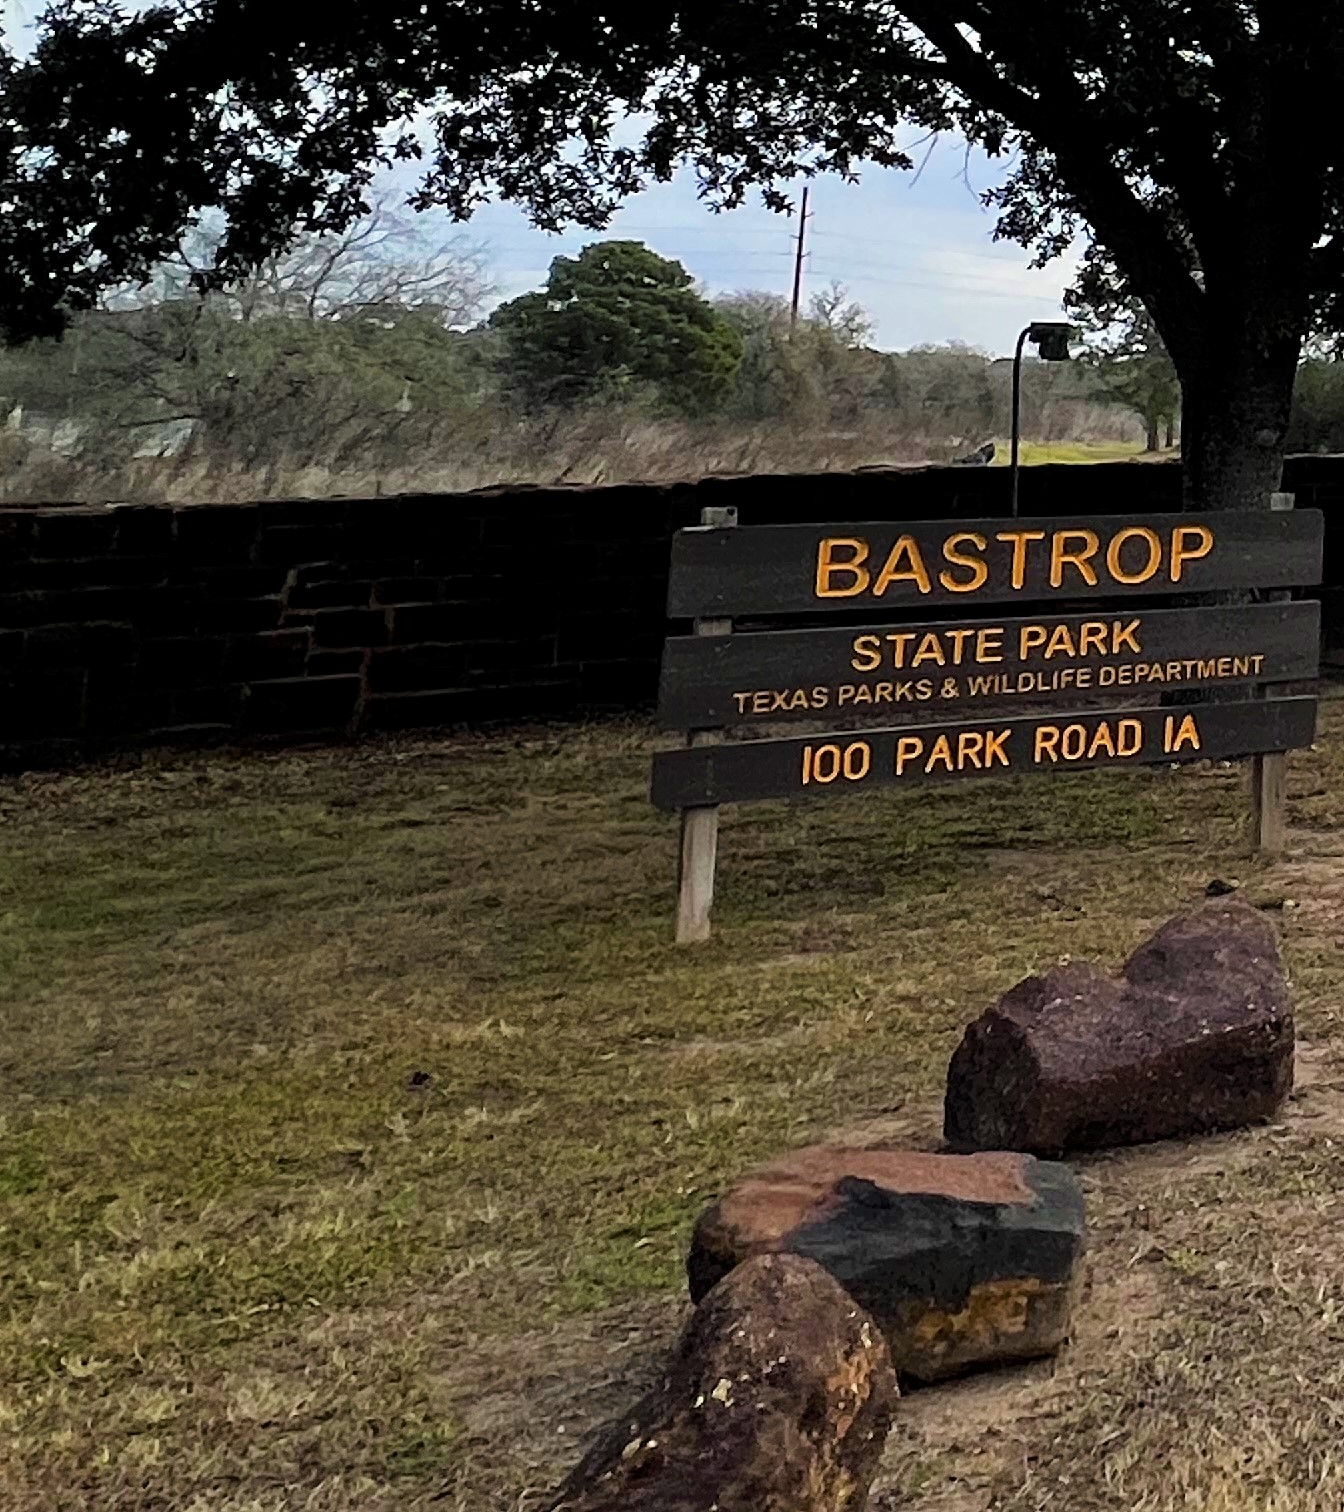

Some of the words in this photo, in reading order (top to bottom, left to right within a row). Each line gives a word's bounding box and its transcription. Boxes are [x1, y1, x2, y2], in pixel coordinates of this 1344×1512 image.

[815, 525, 1214, 598] BASTROP
[851, 627, 1004, 672] STATE
[1019, 618, 1142, 661] PARK
[733, 686, 828, 714] TEXAS
[838, 678, 934, 706] PARKS
[940, 676, 960, 699] &
[967, 666, 1092, 696] WILDLIFE
[1099, 654, 1265, 687] DEPARTMENT
[802, 741, 871, 785] 100
[896, 728, 1012, 776] PARK
[1034, 718, 1143, 764] ROAD
